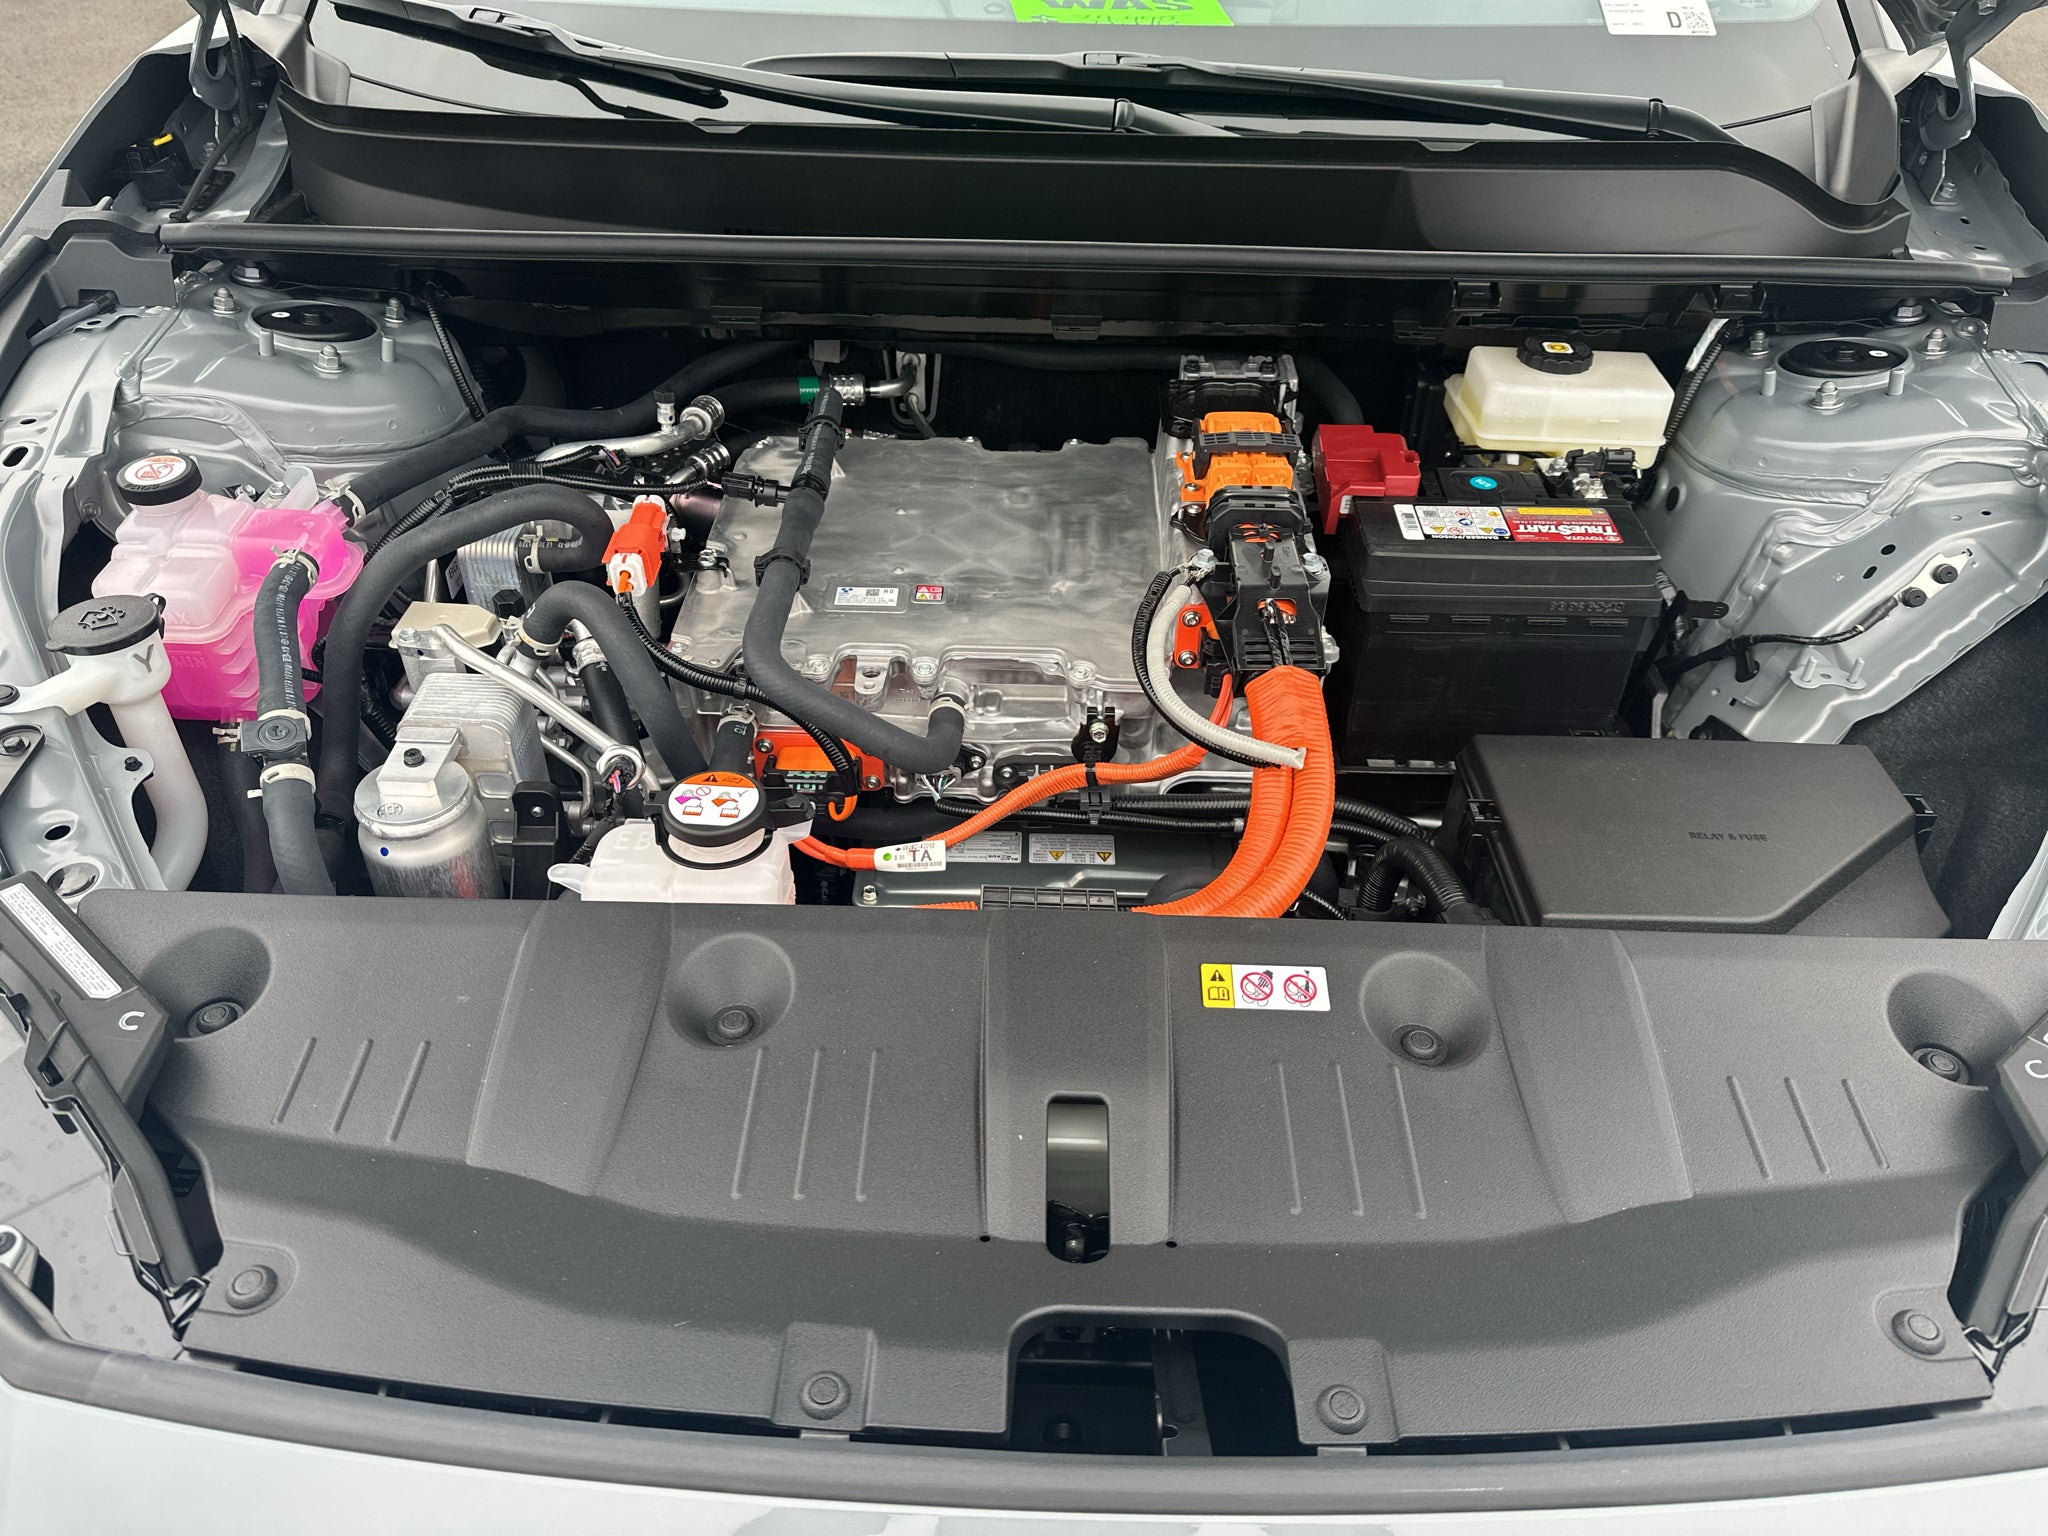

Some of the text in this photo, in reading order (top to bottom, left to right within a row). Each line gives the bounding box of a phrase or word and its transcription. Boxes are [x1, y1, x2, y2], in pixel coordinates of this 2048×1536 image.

[1666, 11, 1682, 28] D
[132, 643, 154, 673] Y
[1688, 831, 1769, 842] RELAY & FUSE
[909, 848, 932, 862] TA
[118, 1010, 145, 1031] C
